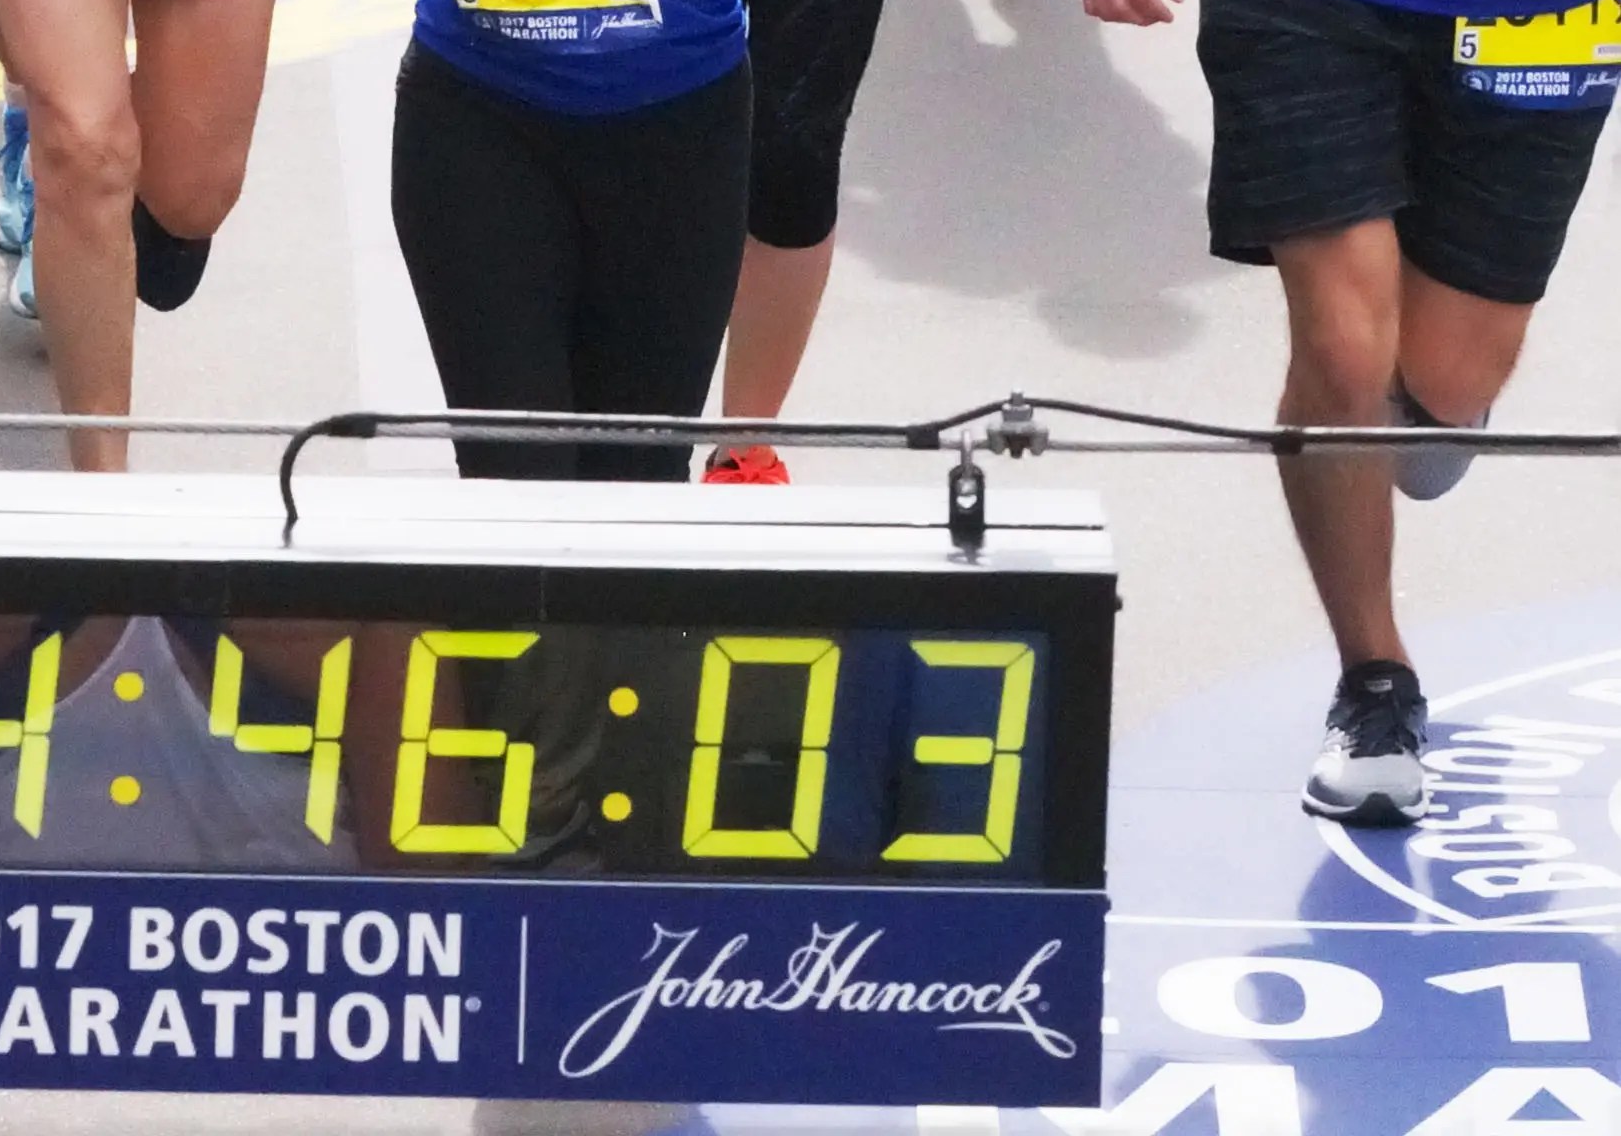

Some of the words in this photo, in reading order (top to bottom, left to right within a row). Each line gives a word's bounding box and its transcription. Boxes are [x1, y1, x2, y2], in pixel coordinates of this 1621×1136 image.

[527, 15, 578, 28] BOSTON
[500, 27, 578, 40] MARATHON
[1459, 33, 1478, 60] 5
[1495, 71, 1523, 83] 2017
[1525, 71, 1570, 83] BOSTON
[1494, 83, 1570, 97] MARATHON
[129, 906, 462, 978] BOSTON
[558, 921, 768, 1078] John
[762, 921, 1077, 1060] Hancock
